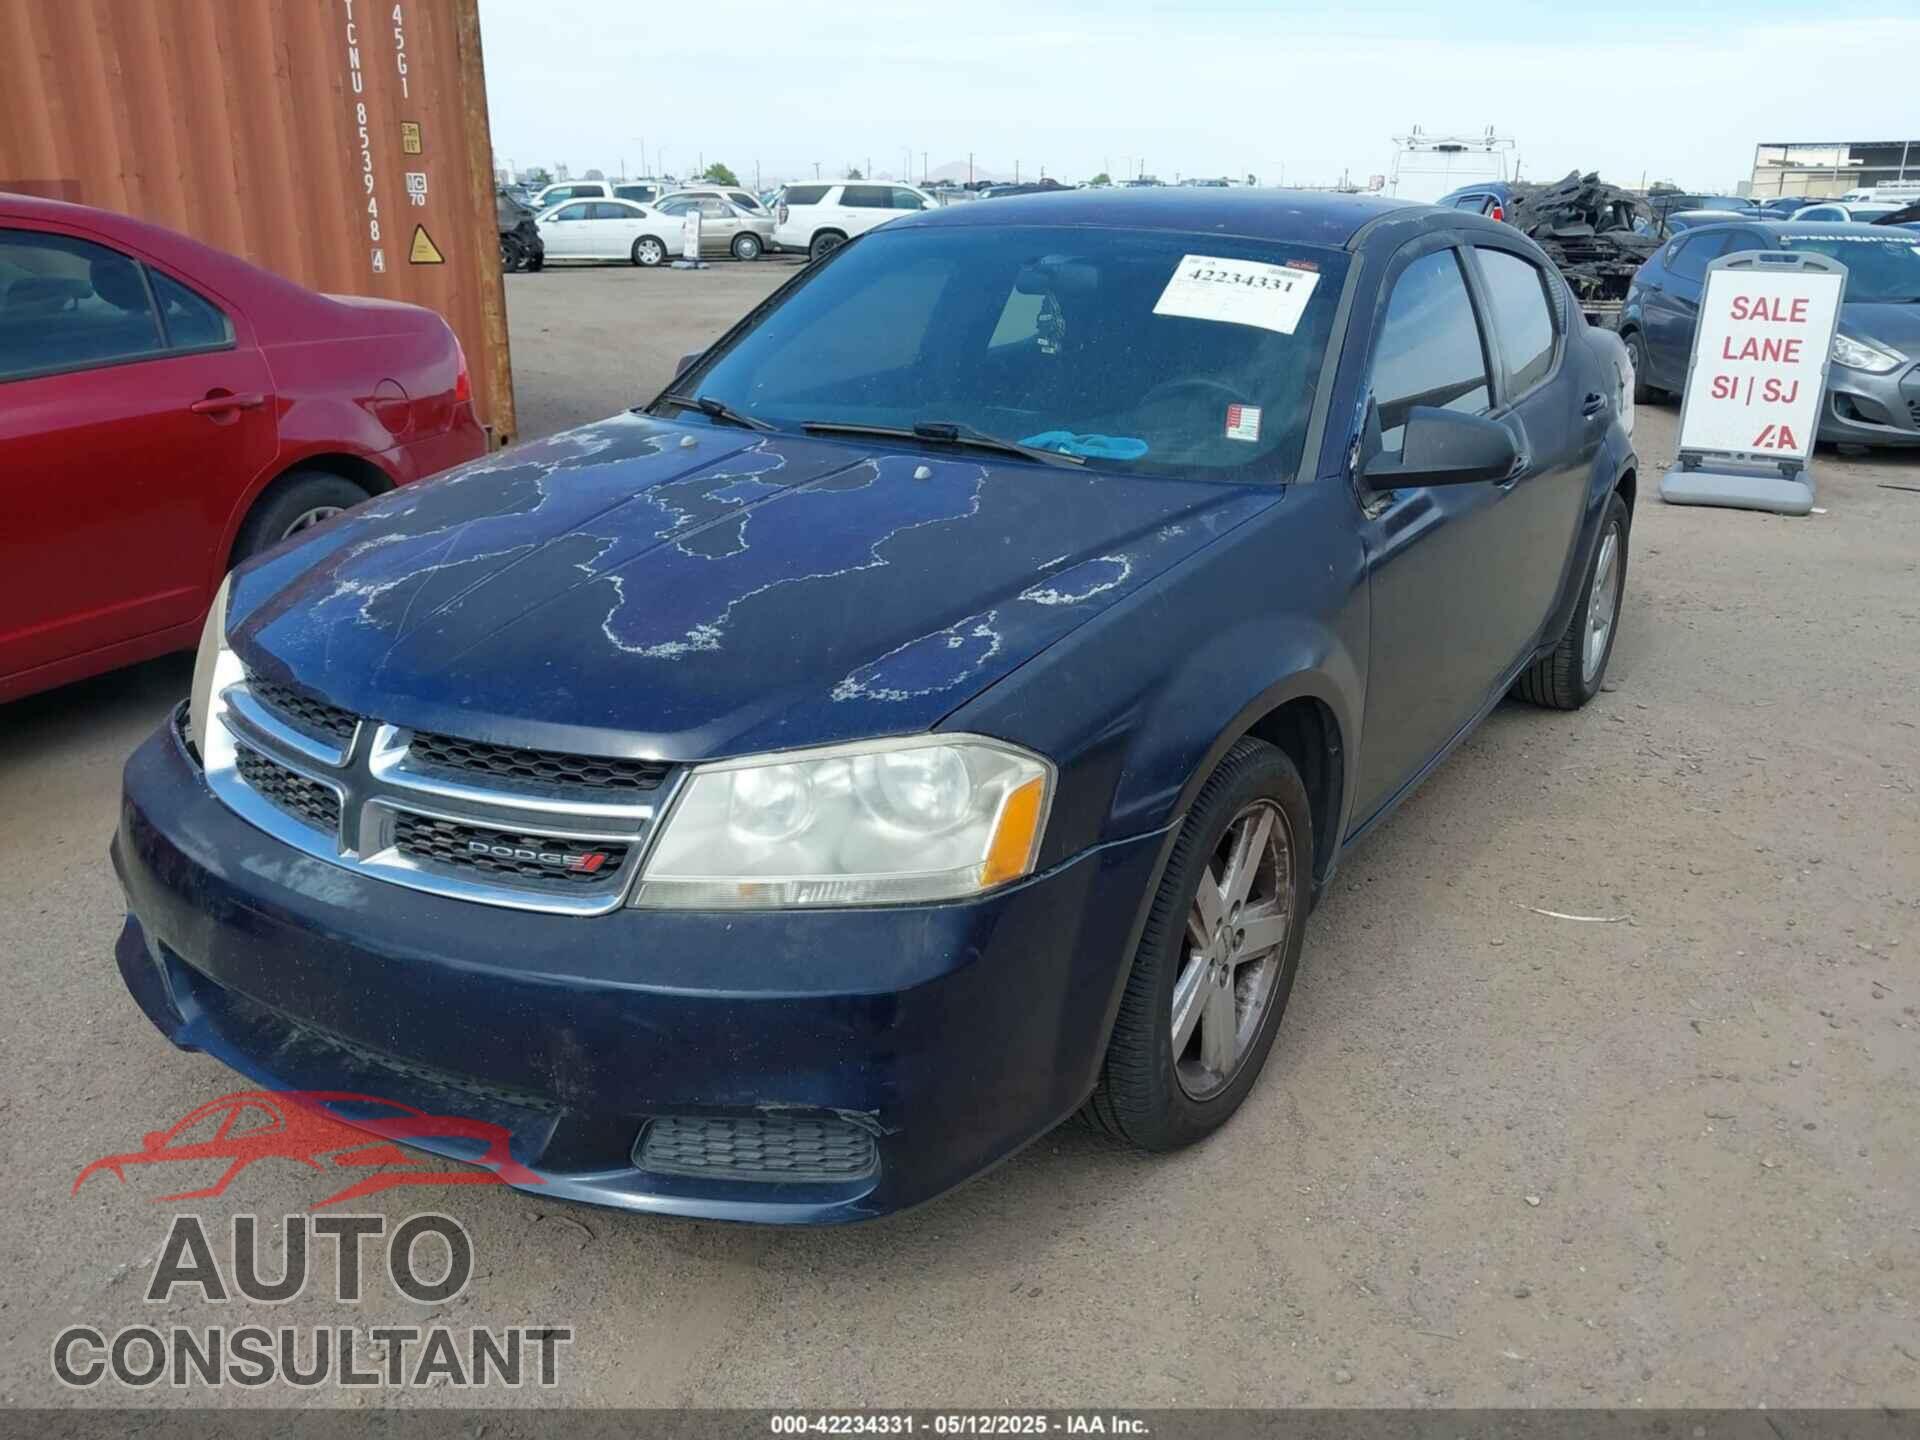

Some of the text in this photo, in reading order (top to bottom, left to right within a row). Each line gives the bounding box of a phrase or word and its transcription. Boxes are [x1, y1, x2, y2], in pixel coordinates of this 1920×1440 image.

[392, 4, 408, 98] 45G1
[356, 103, 380, 241] 853948
[373, 252, 384, 271] 4
[409, 193, 425, 206] 70
[1188, 268, 1294, 293] 42234331
[1730, 296, 1810, 323] SALE
[1722, 336, 1803, 363] LANE
[1711, 376, 1739, 400] SI
[1762, 379, 1799, 404] SJ
[469, 841, 585, 867] DODGE
